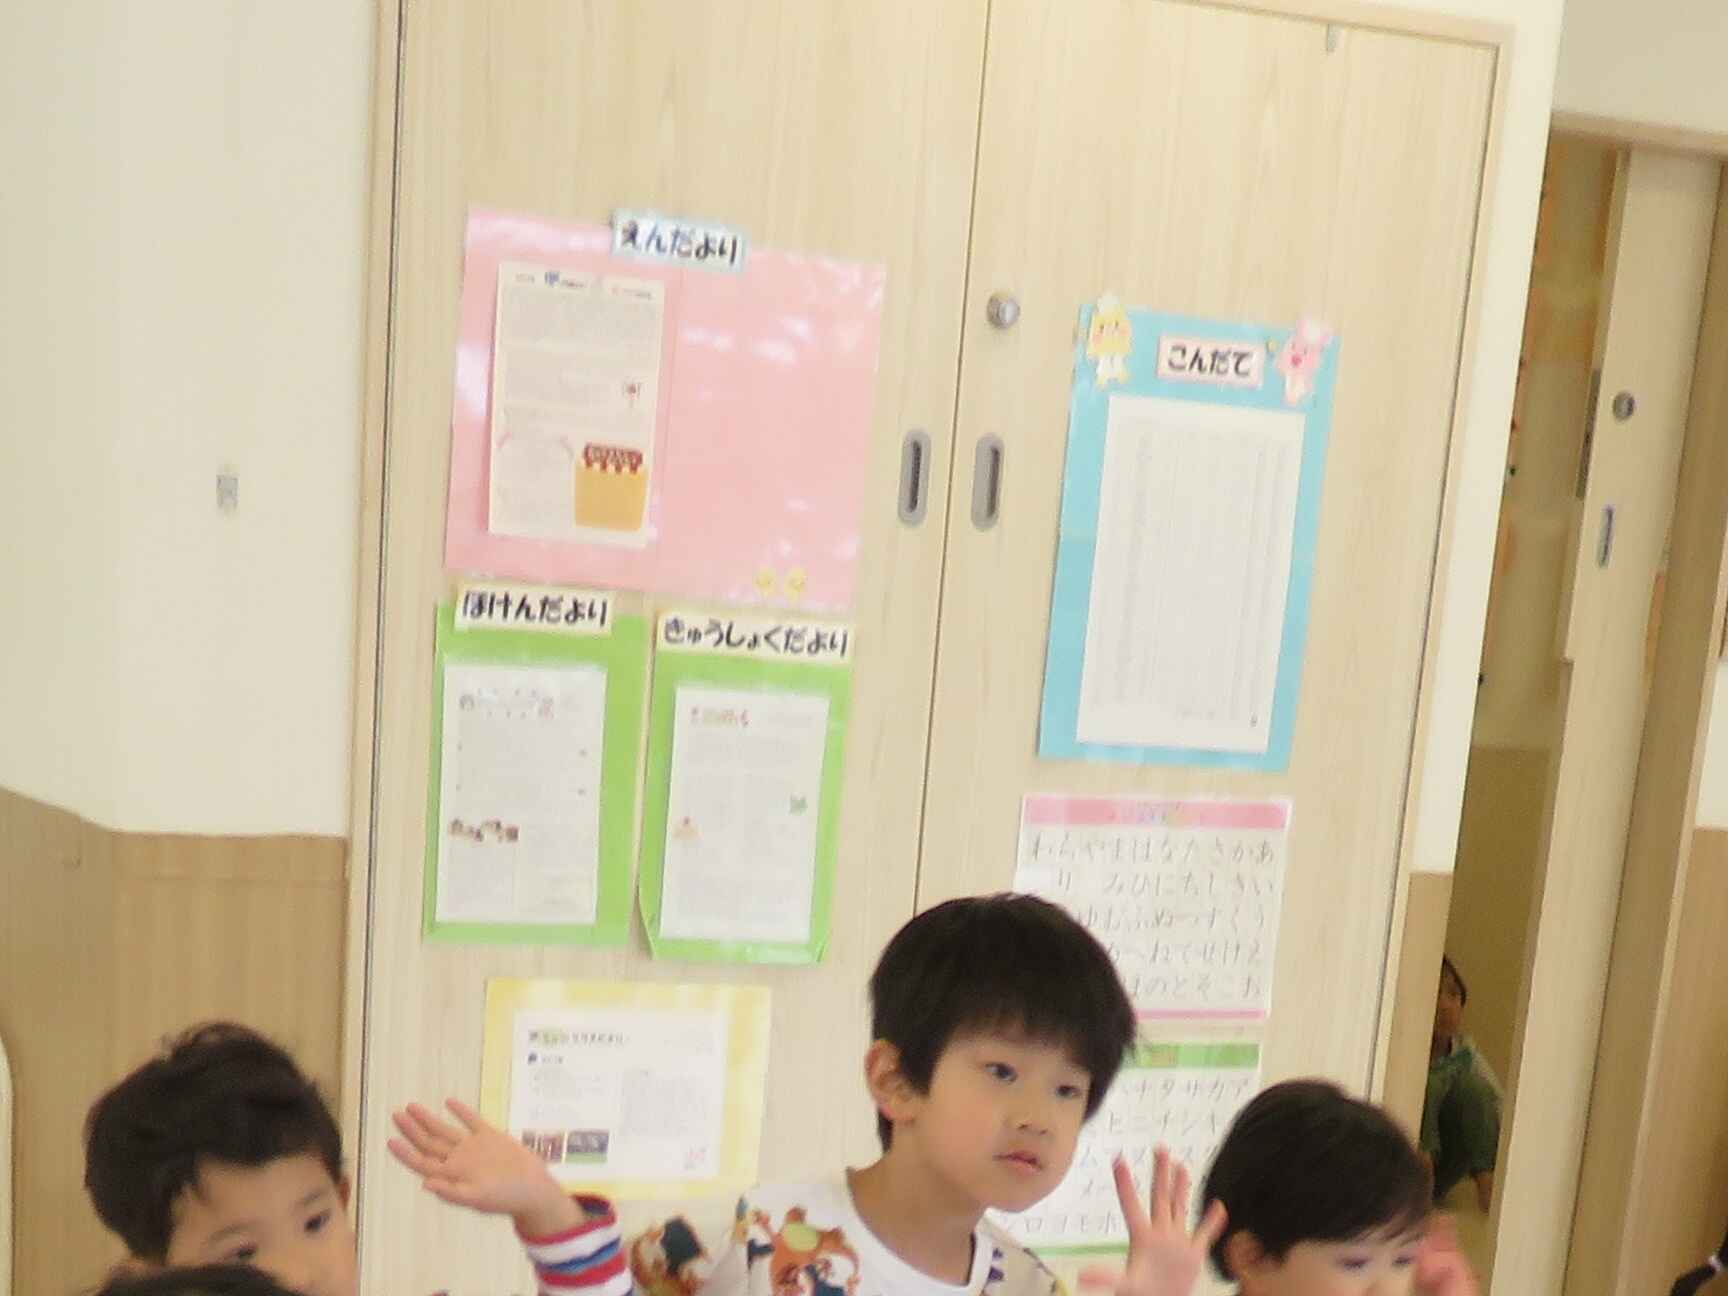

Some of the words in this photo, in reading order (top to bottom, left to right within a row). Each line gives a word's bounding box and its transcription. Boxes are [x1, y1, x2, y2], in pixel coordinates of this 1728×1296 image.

[621, 220, 738, 267] えんだより
[1168, 344, 1250, 377] こんだて
[462, 590, 608, 627] ほけんだより
[664, 616, 848, 658] きゅうしょくだより
